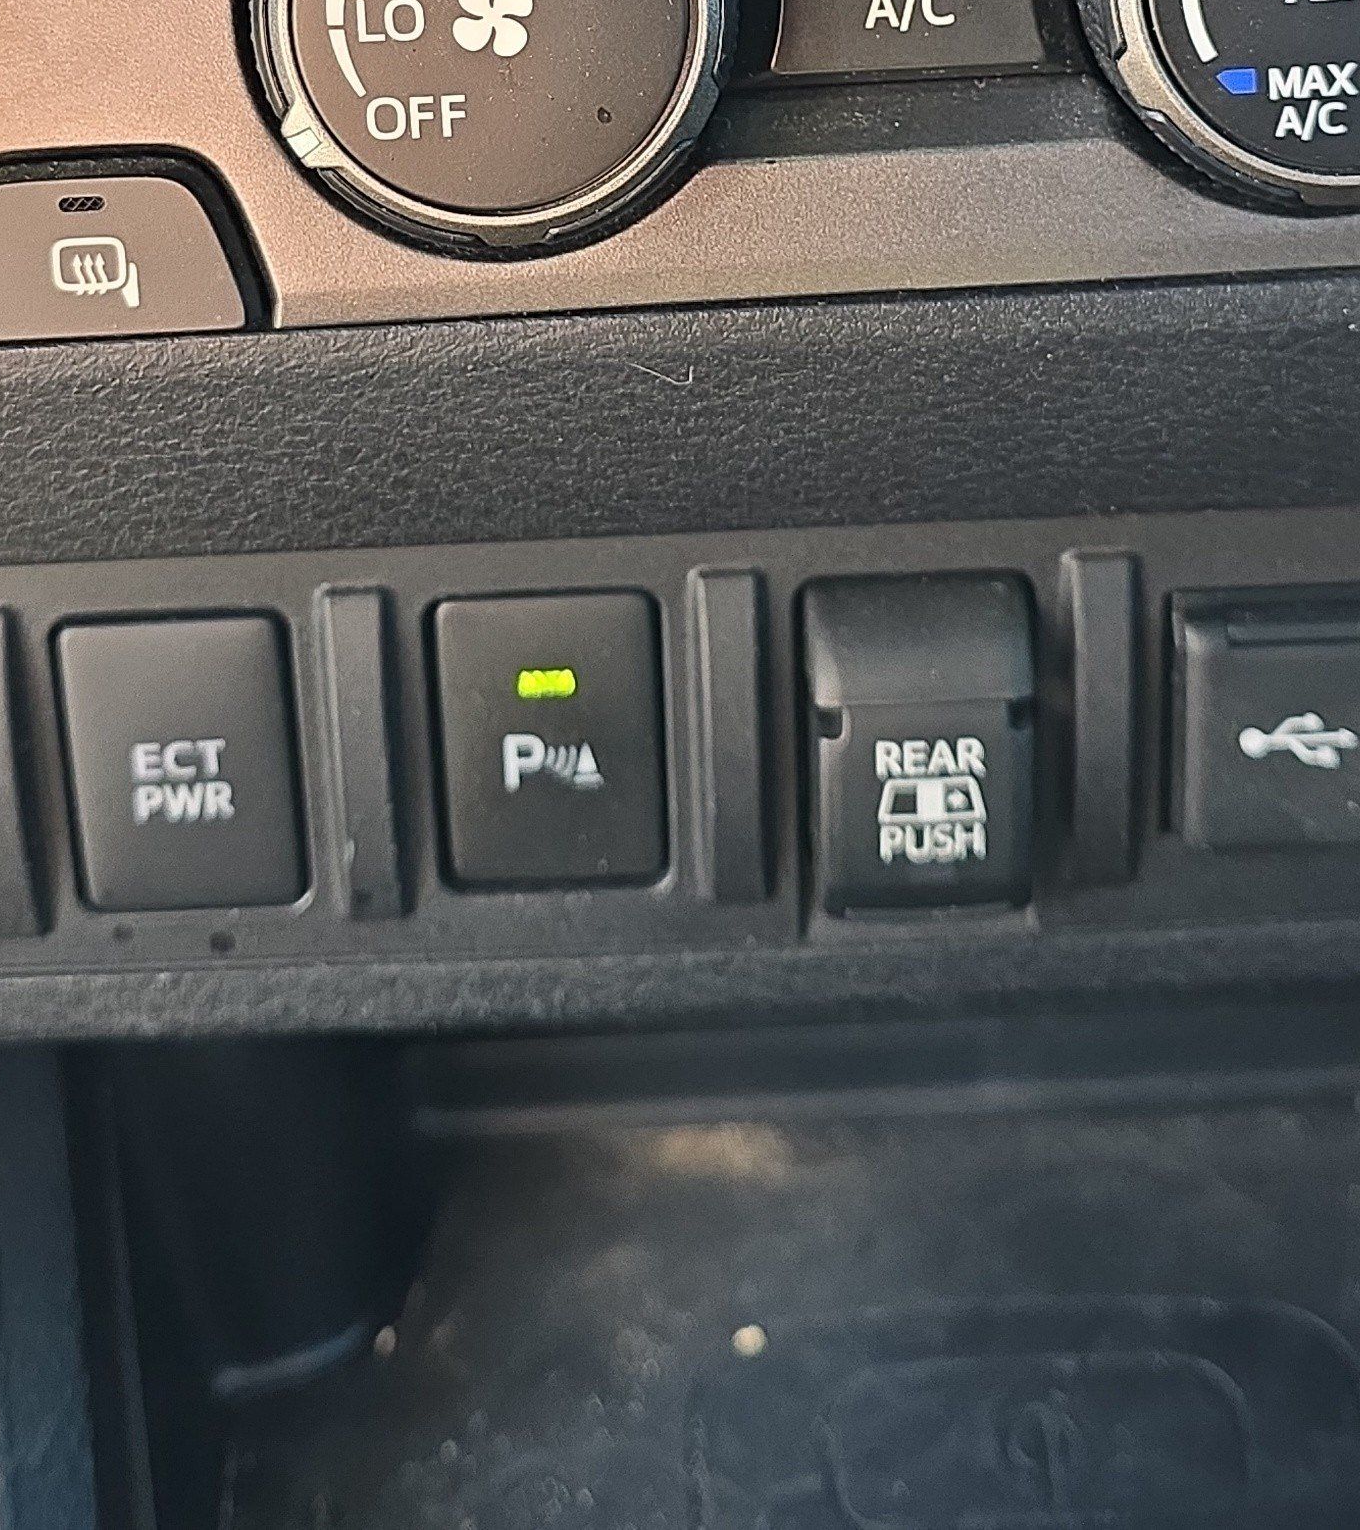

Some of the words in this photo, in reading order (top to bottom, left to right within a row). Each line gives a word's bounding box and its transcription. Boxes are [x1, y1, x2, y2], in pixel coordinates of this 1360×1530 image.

[1268, 62, 1359, 101] MAX
[364, 93, 467, 141] OFF
[1275, 101, 1348, 141] A/C
[131, 738, 226, 783] ECT
[874, 737, 986, 779] REAR
[133, 780, 235, 823] PWR
[878, 822, 987, 864] PUSH
